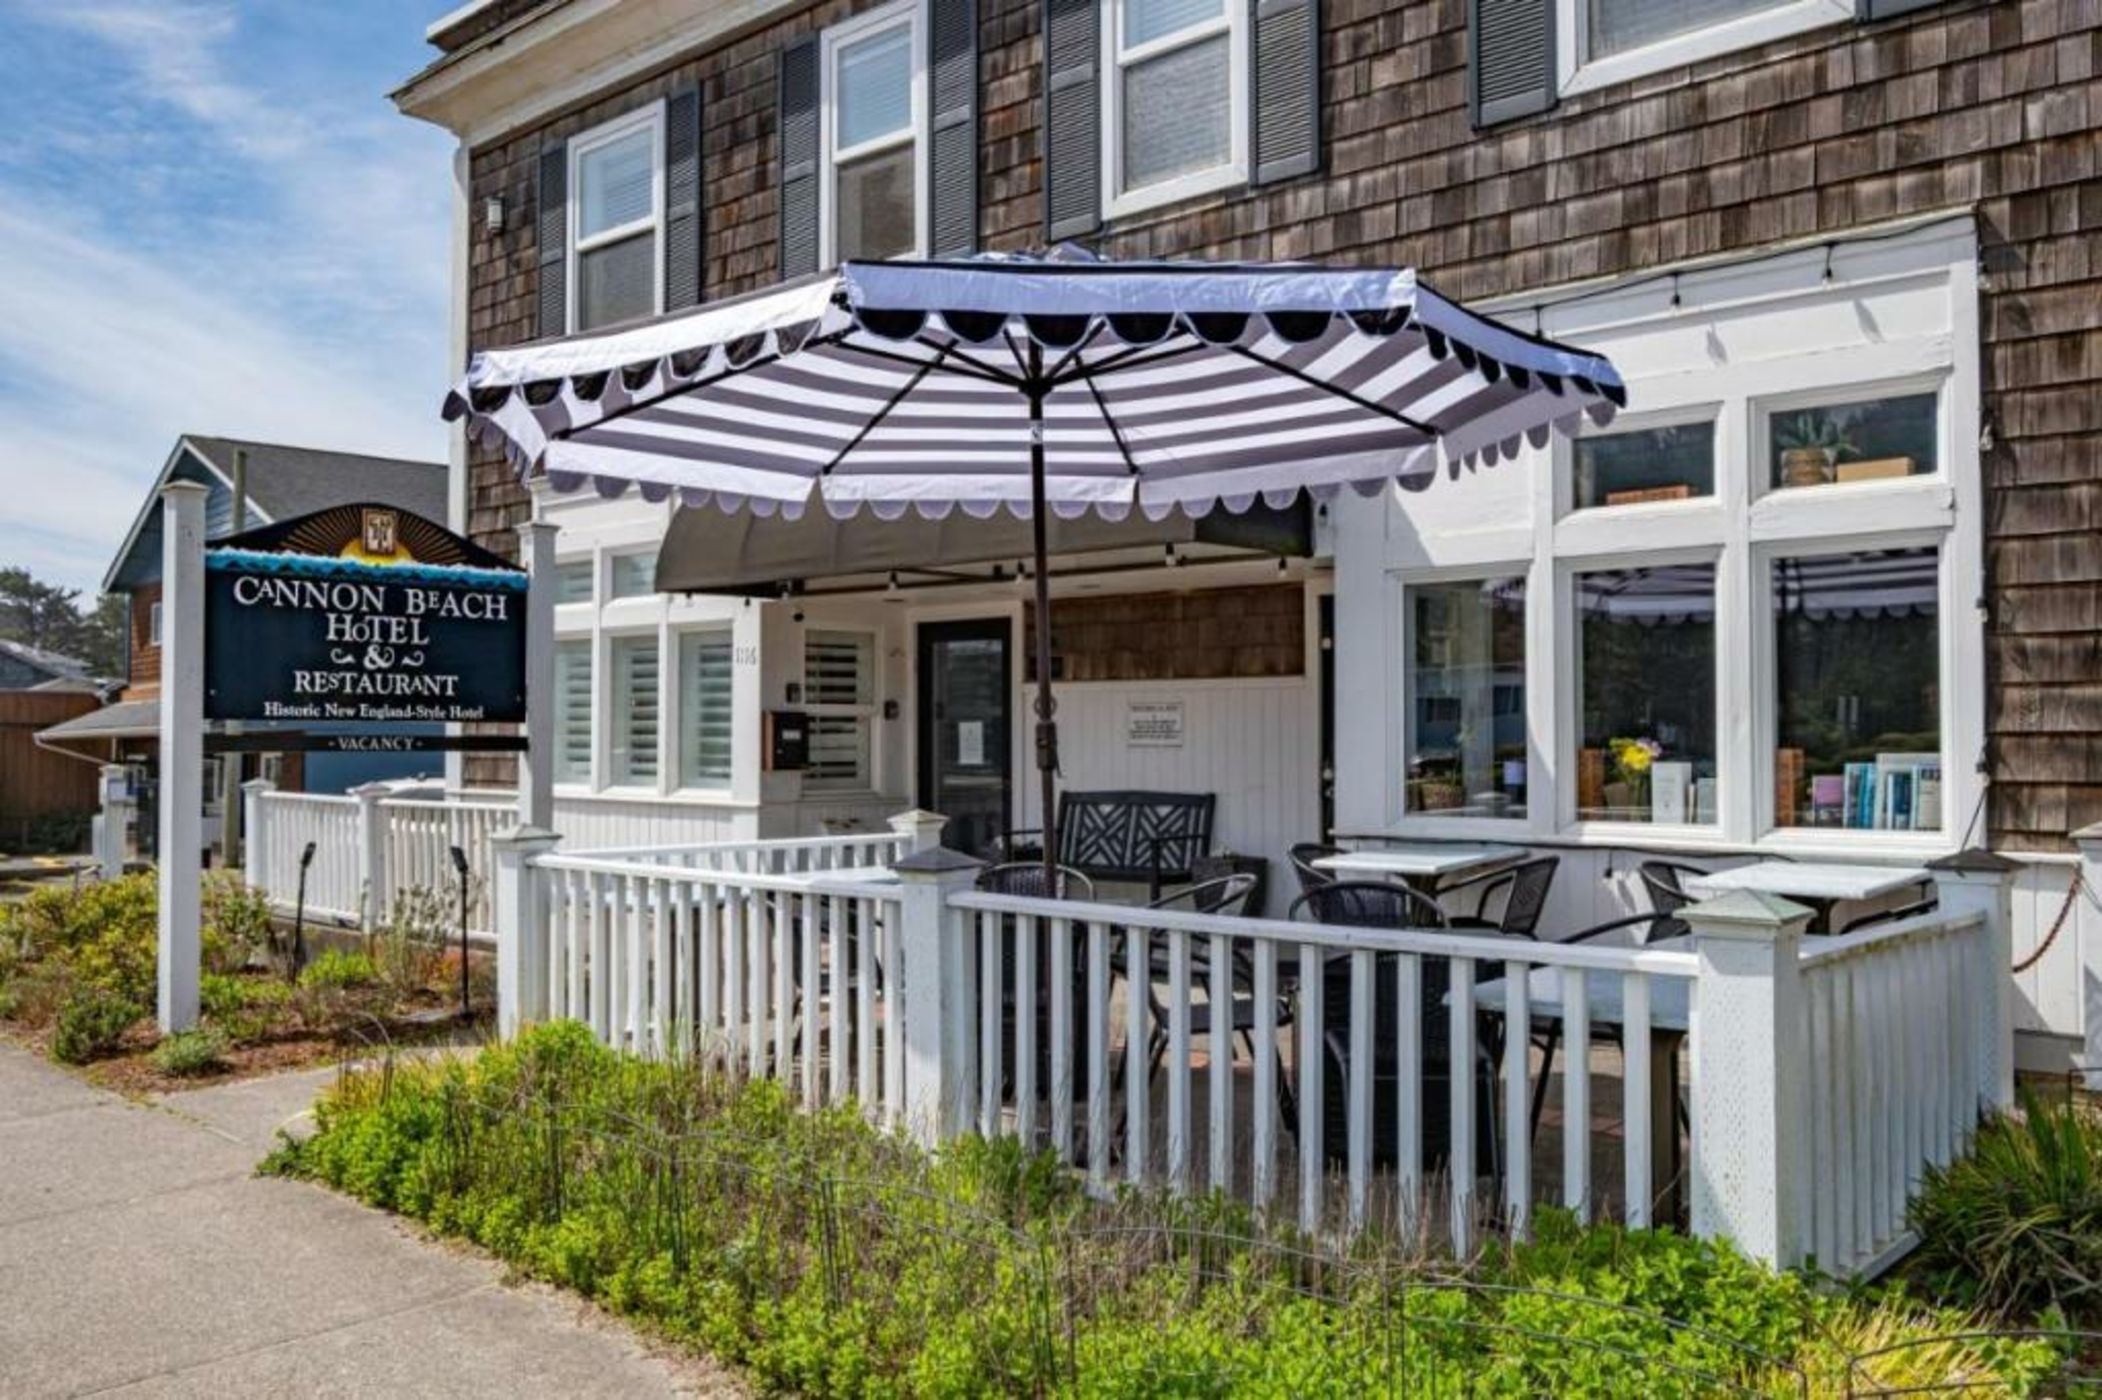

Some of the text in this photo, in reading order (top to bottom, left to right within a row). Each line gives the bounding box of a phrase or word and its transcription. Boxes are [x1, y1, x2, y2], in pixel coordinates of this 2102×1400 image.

[233, 576, 508, 620] CANNON BEACH
[326, 612, 430, 646] HOTEL
[362, 644, 395, 670] &
[293, 670, 459, 696] RESTAURANT
[263, 701, 484, 720] Historic New England-Style Hotel
